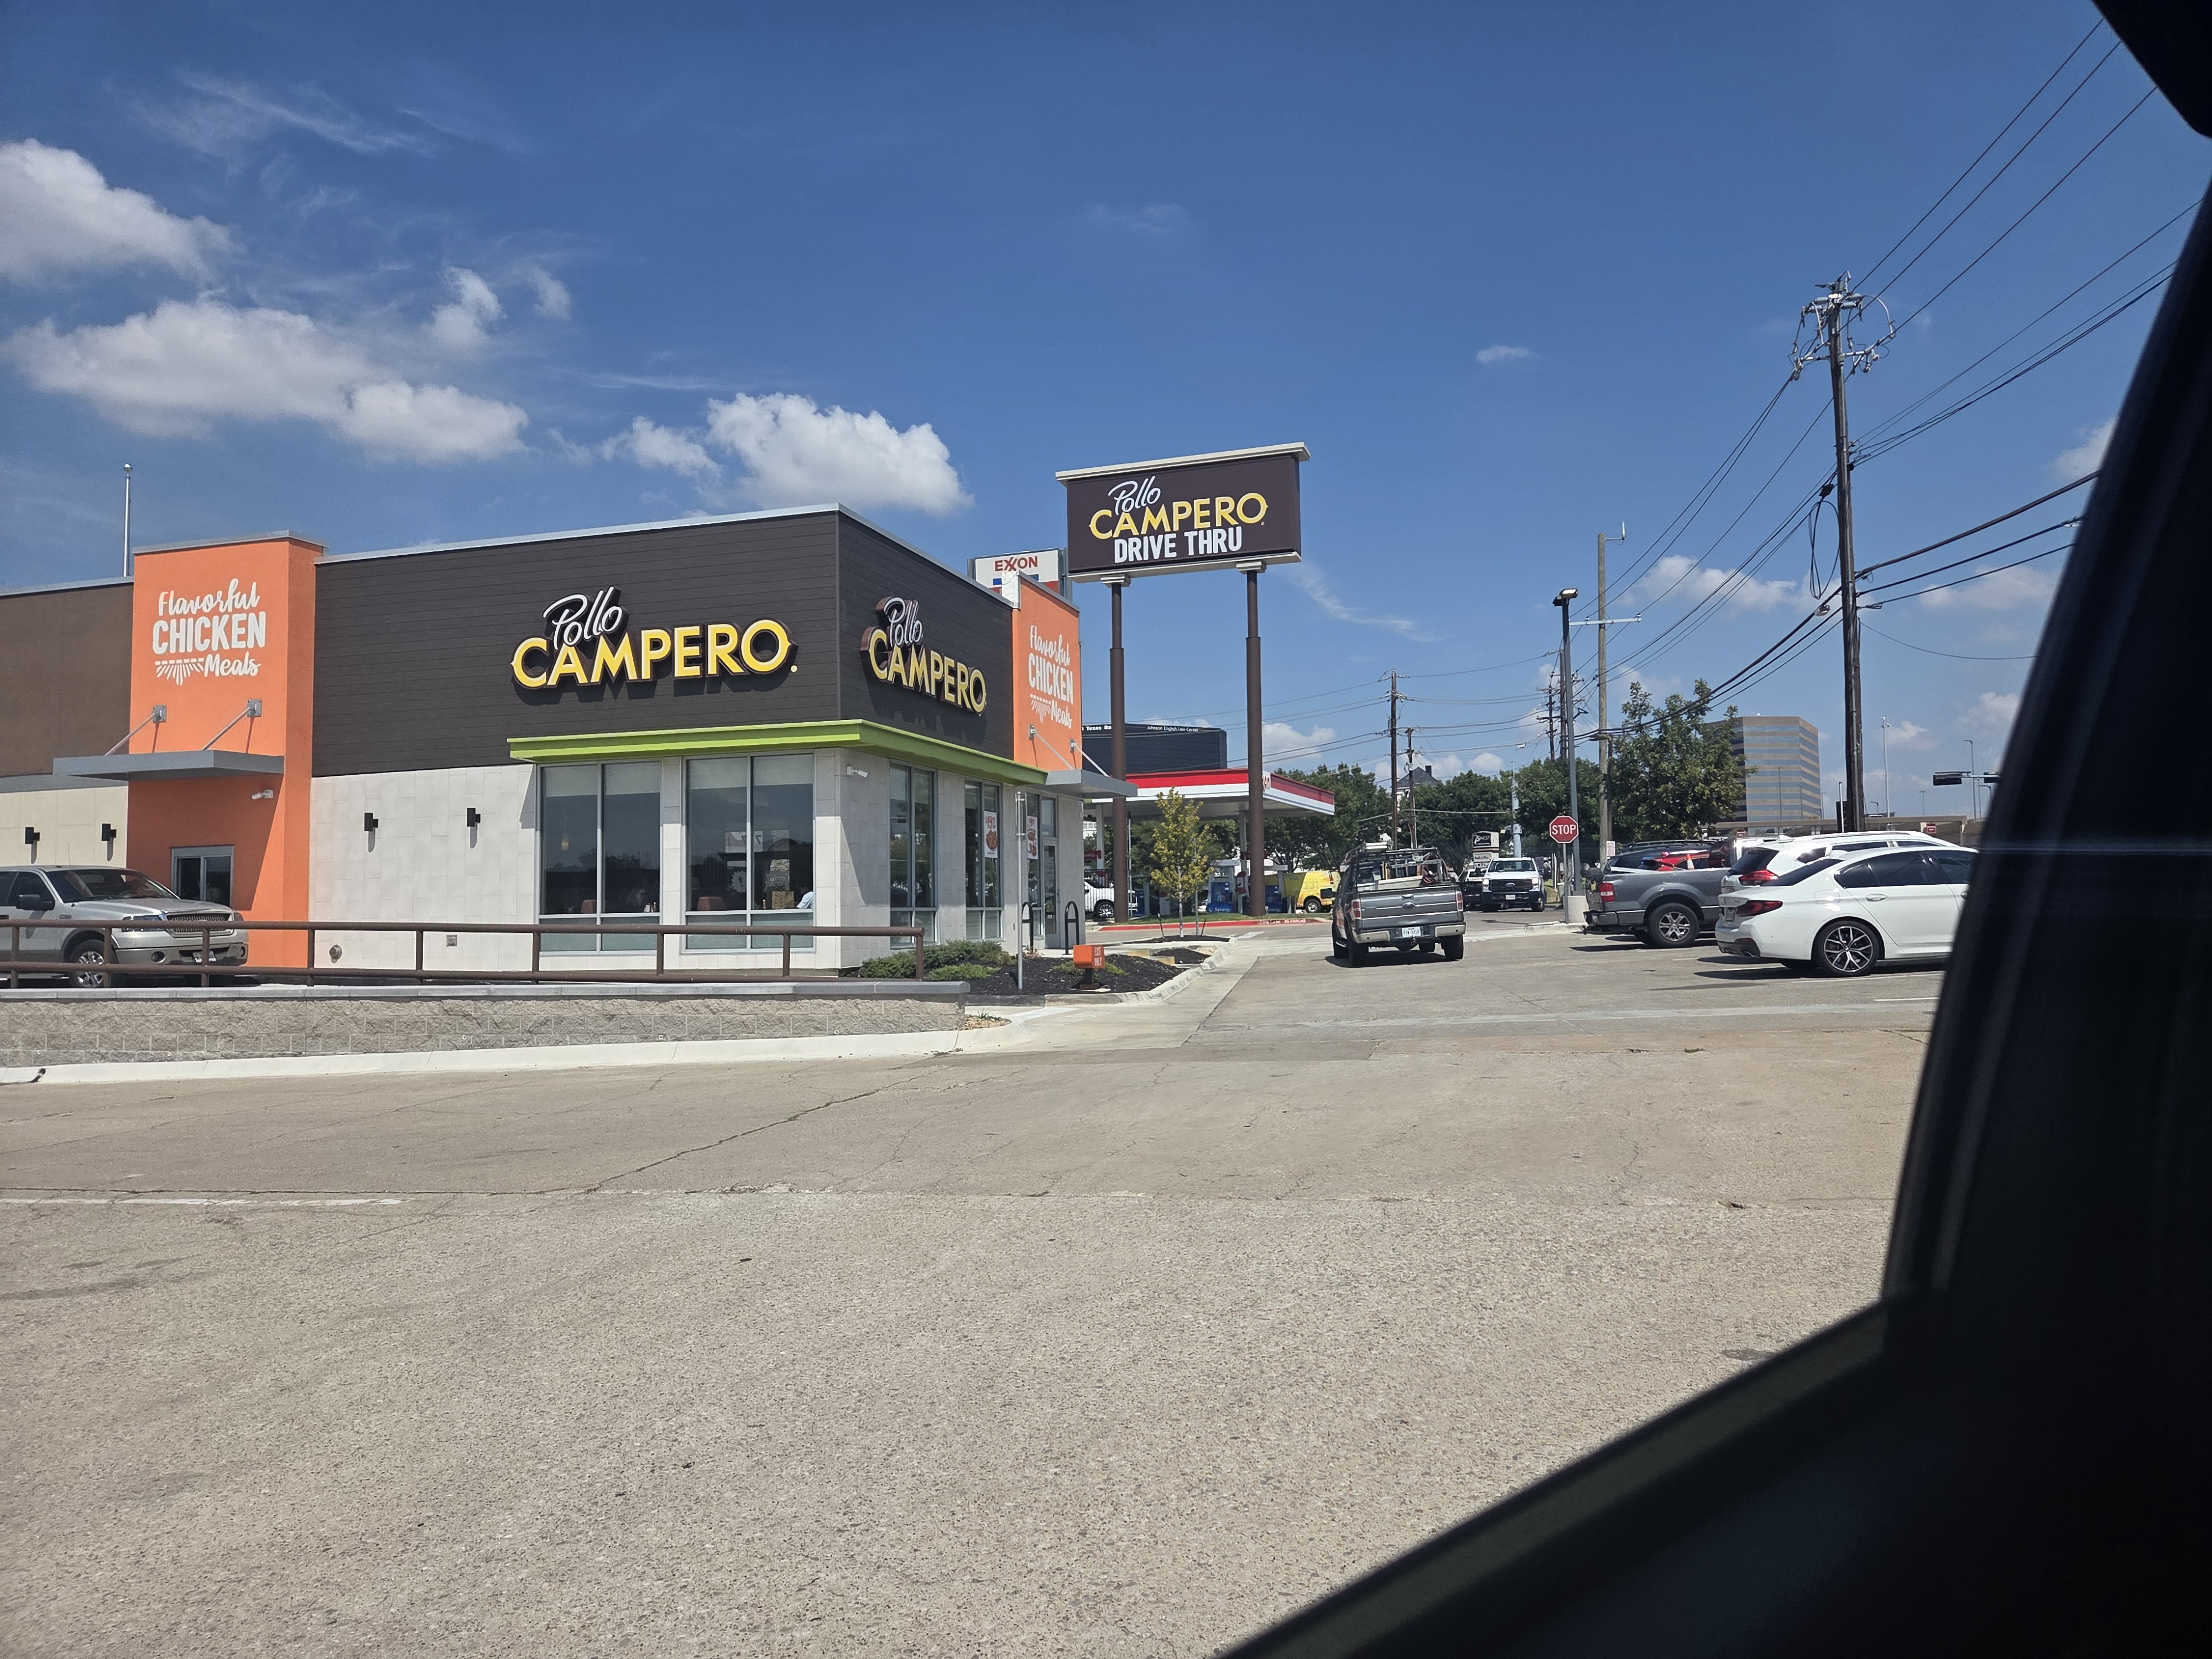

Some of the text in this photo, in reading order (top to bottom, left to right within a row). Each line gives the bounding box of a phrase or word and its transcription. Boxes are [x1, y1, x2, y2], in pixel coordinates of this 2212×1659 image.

[1108, 476, 1161, 515] Pollo
[994, 556, 1038, 572] EXXON
[1114, 526, 1242, 564] DRIVE THRU
[158, 578, 260, 616] Flavorful
[152, 611, 265, 654] CHICKEN
[542, 586, 622, 650] Pollo
[883, 597, 922, 647] Pollo
[204, 651, 262, 677] Meals
[1030, 625, 1071, 666] Flavorful
[1028, 653, 1073, 705] CHICKEN
[1051, 699, 1073, 729] Meals
[1552, 824, 1576, 835] STOP
